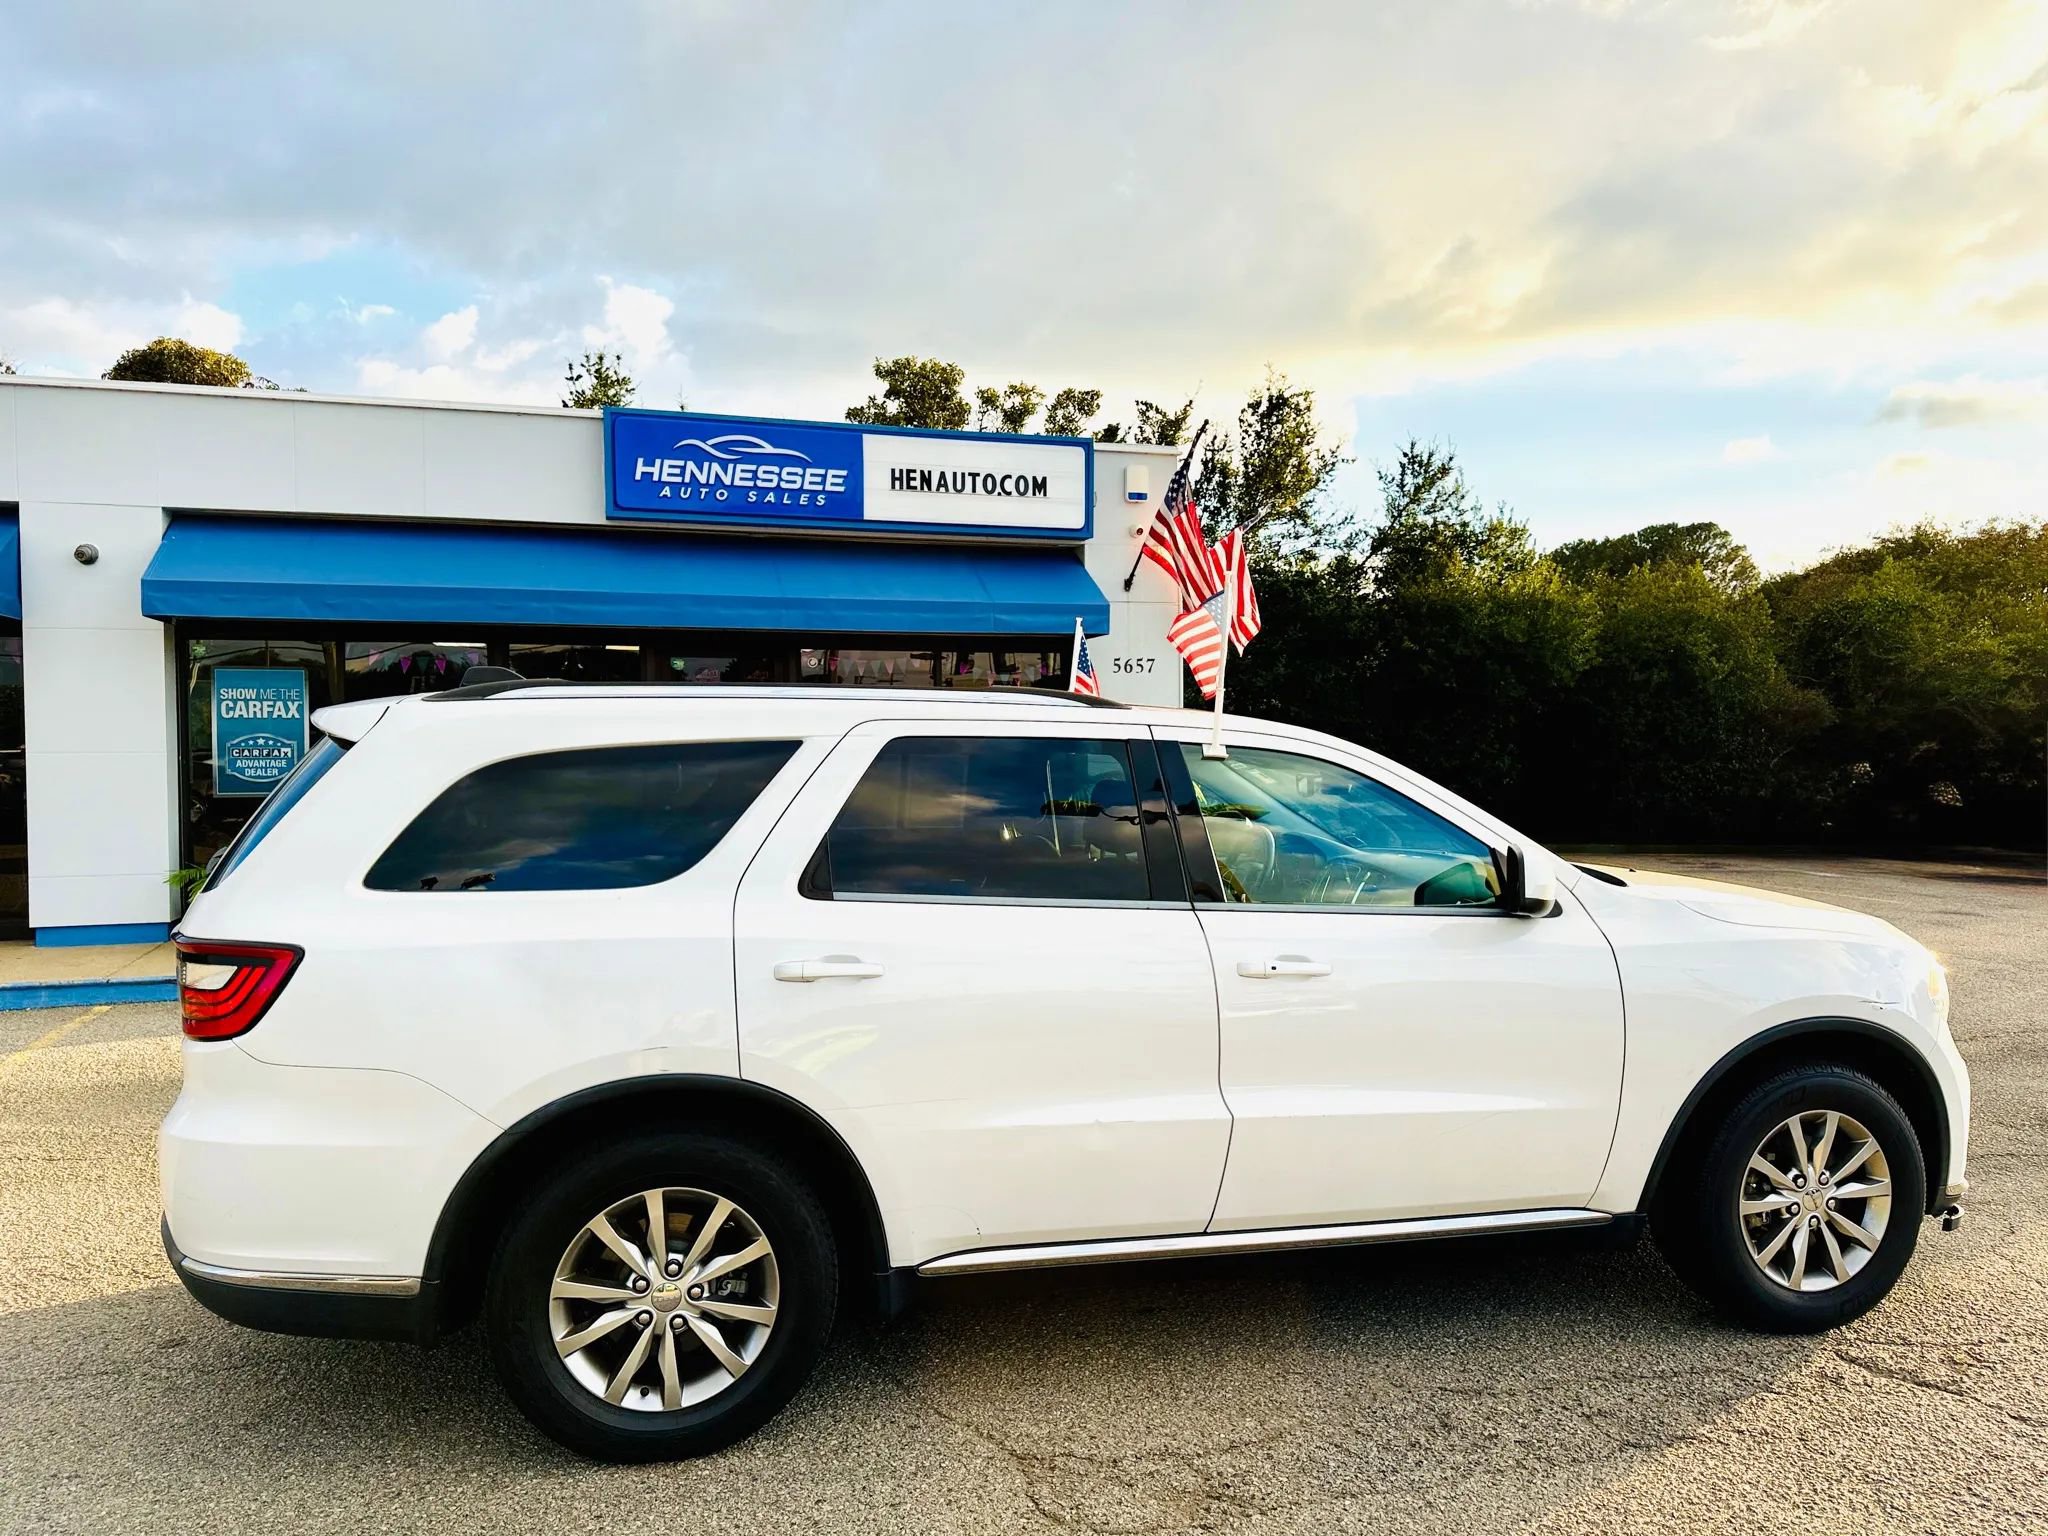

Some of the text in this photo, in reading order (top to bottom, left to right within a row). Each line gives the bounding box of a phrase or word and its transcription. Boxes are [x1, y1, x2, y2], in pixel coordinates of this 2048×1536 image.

[634, 457, 848, 492] HENNESSEE
[890, 468, 1048, 497] HENAUTO.COM
[659, 486, 827, 506] AUTO SALES
[1112, 657, 1156, 674] 5657
[220, 688, 300, 700] SHOW ME THE
[221, 700, 301, 719] CARFAX
[232, 748, 291, 758] CARFAX
[236, 760, 287, 768] ADVANTAGE
[245, 768, 279, 776] DEALER
